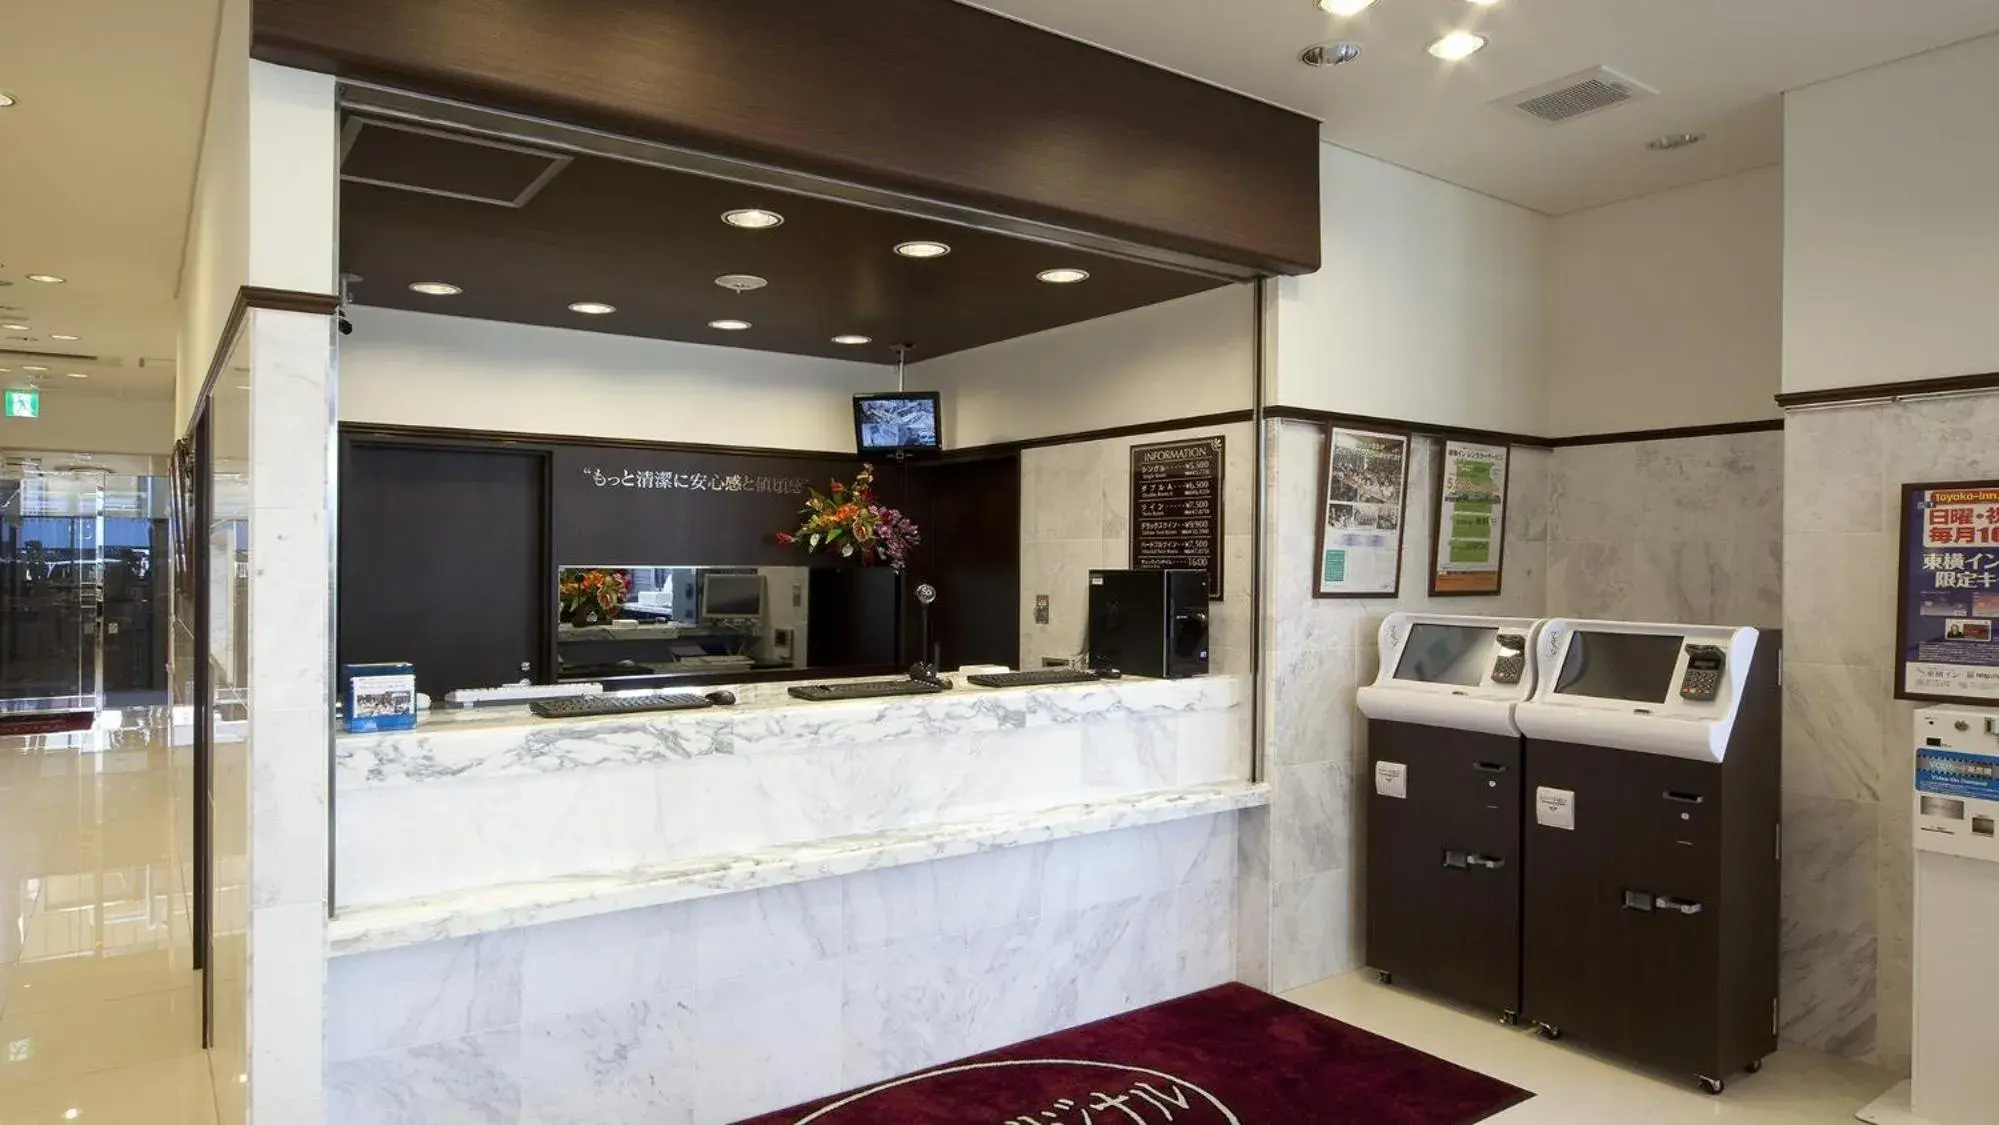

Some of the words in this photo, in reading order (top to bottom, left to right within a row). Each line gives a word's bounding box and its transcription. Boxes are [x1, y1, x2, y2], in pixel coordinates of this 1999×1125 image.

[1144, 448, 1207, 461] INFORMATION
[1922, 552, 1999, 570] 東横イン
[1935, 571, 1999, 588] 限定キ
